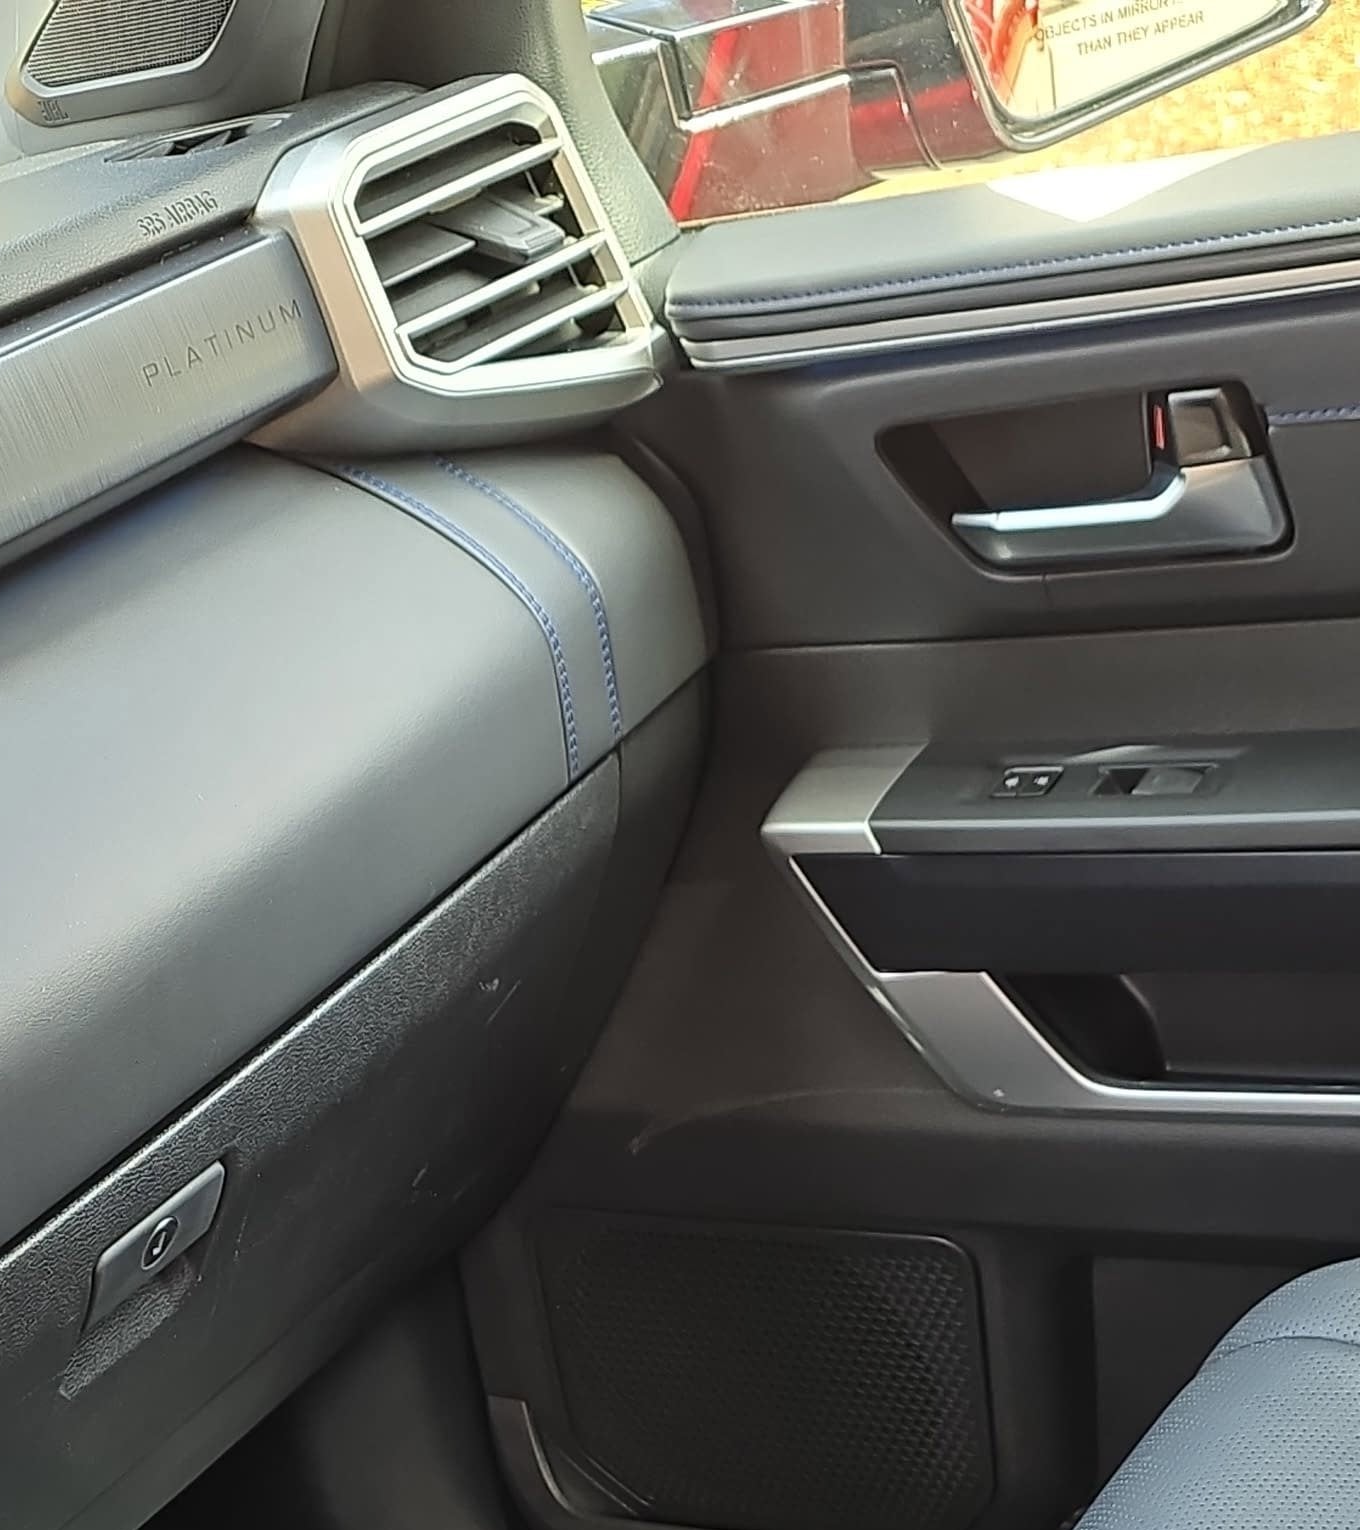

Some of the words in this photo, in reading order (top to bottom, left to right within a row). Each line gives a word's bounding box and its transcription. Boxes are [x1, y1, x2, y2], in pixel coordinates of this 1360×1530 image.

[1077, 35, 1112, 56] THAN
[1117, 25, 1150, 46] THEY
[1154, 10, 1205, 35] APPEAR
[1101, 11, 1114, 25] IN
[136, 211, 167, 238] SRS
[163, 190, 219, 229] AIRBAG
[142, 298, 303, 388] PLATINUM
